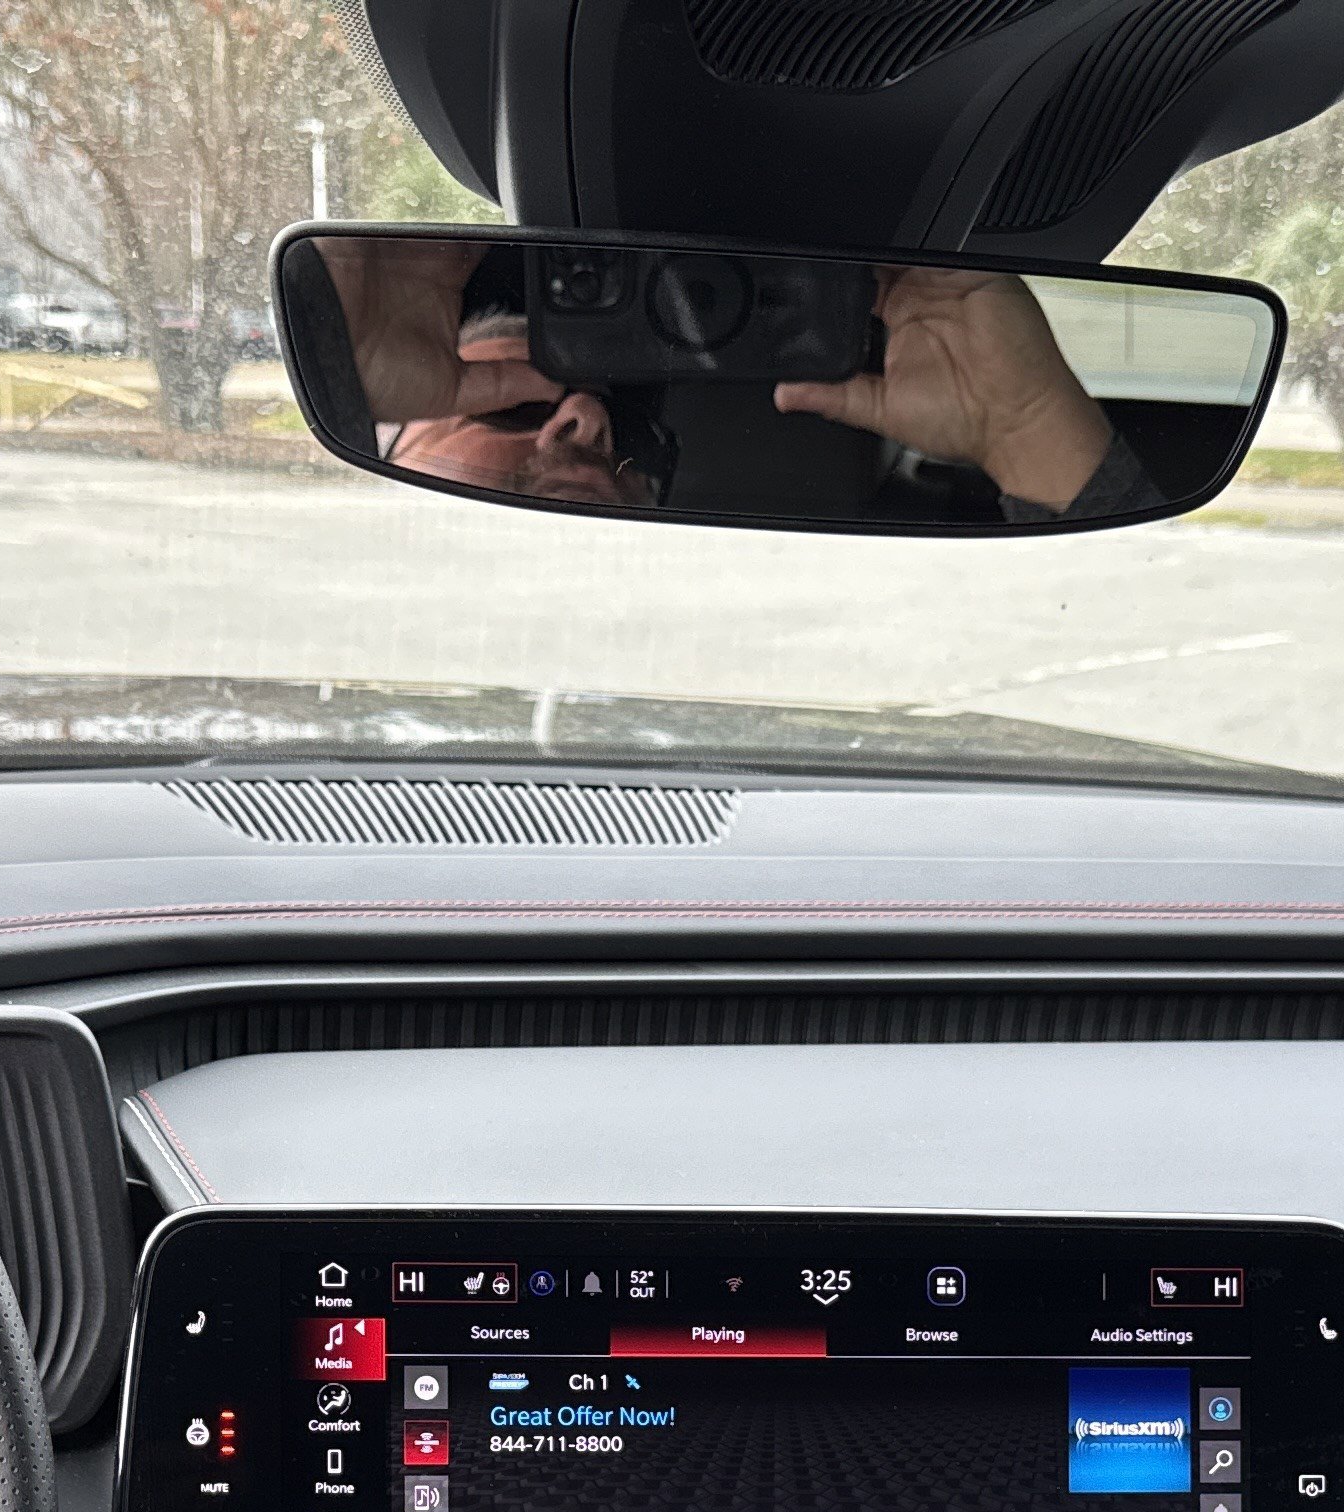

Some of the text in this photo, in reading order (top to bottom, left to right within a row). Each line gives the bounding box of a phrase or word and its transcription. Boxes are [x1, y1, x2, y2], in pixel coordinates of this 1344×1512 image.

[399, 1271, 424, 1292] HI
[799, 1269, 852, 1291] 3:25
[1214, 1277, 1238, 1297] HI
[630, 1286, 655, 1298] OUT
[315, 1295, 353, 1307] Home
[470, 1325, 530, 1341] Sources
[691, 1326, 745, 1344] Playing
[905, 1327, 959, 1343] Browse
[1090, 1328, 1193, 1344] Audio Settings
[315, 1357, 353, 1370] Media
[419, 1383, 434, 1392] FM
[568, 1373, 607, 1391] Ch 1
[490, 1405, 675, 1427] Great Offer Now!
[308, 1419, 361, 1432] Comfort
[489, 1435, 623, 1453] 844-711-8800
[200, 1483, 230, 1494] MUTE
[315, 1482, 355, 1494] Phone
